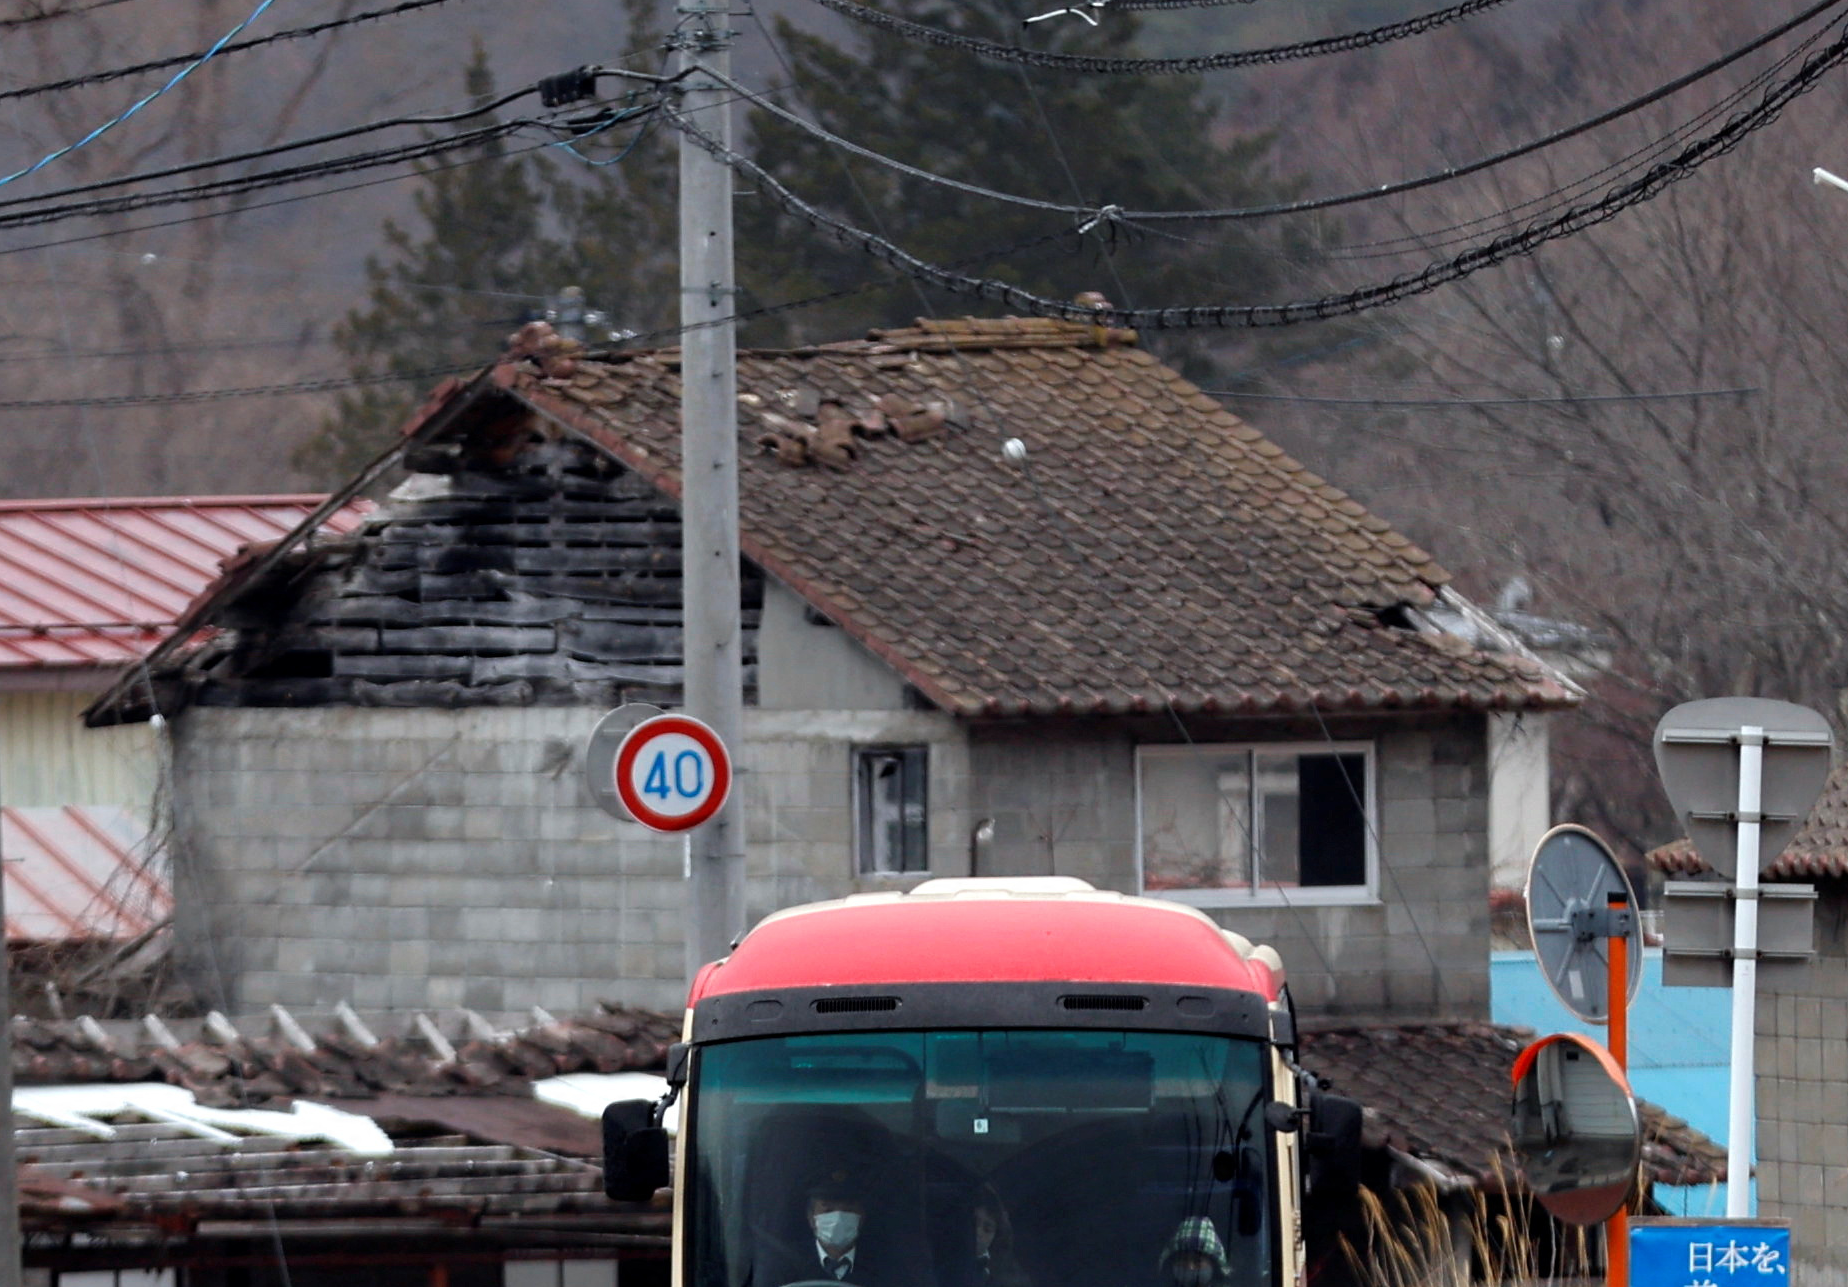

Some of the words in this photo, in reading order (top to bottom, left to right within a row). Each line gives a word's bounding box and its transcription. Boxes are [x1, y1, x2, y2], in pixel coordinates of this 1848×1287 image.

[644, 750, 704, 799] 40
[1688, 1239, 1786, 1275] 日本を、
